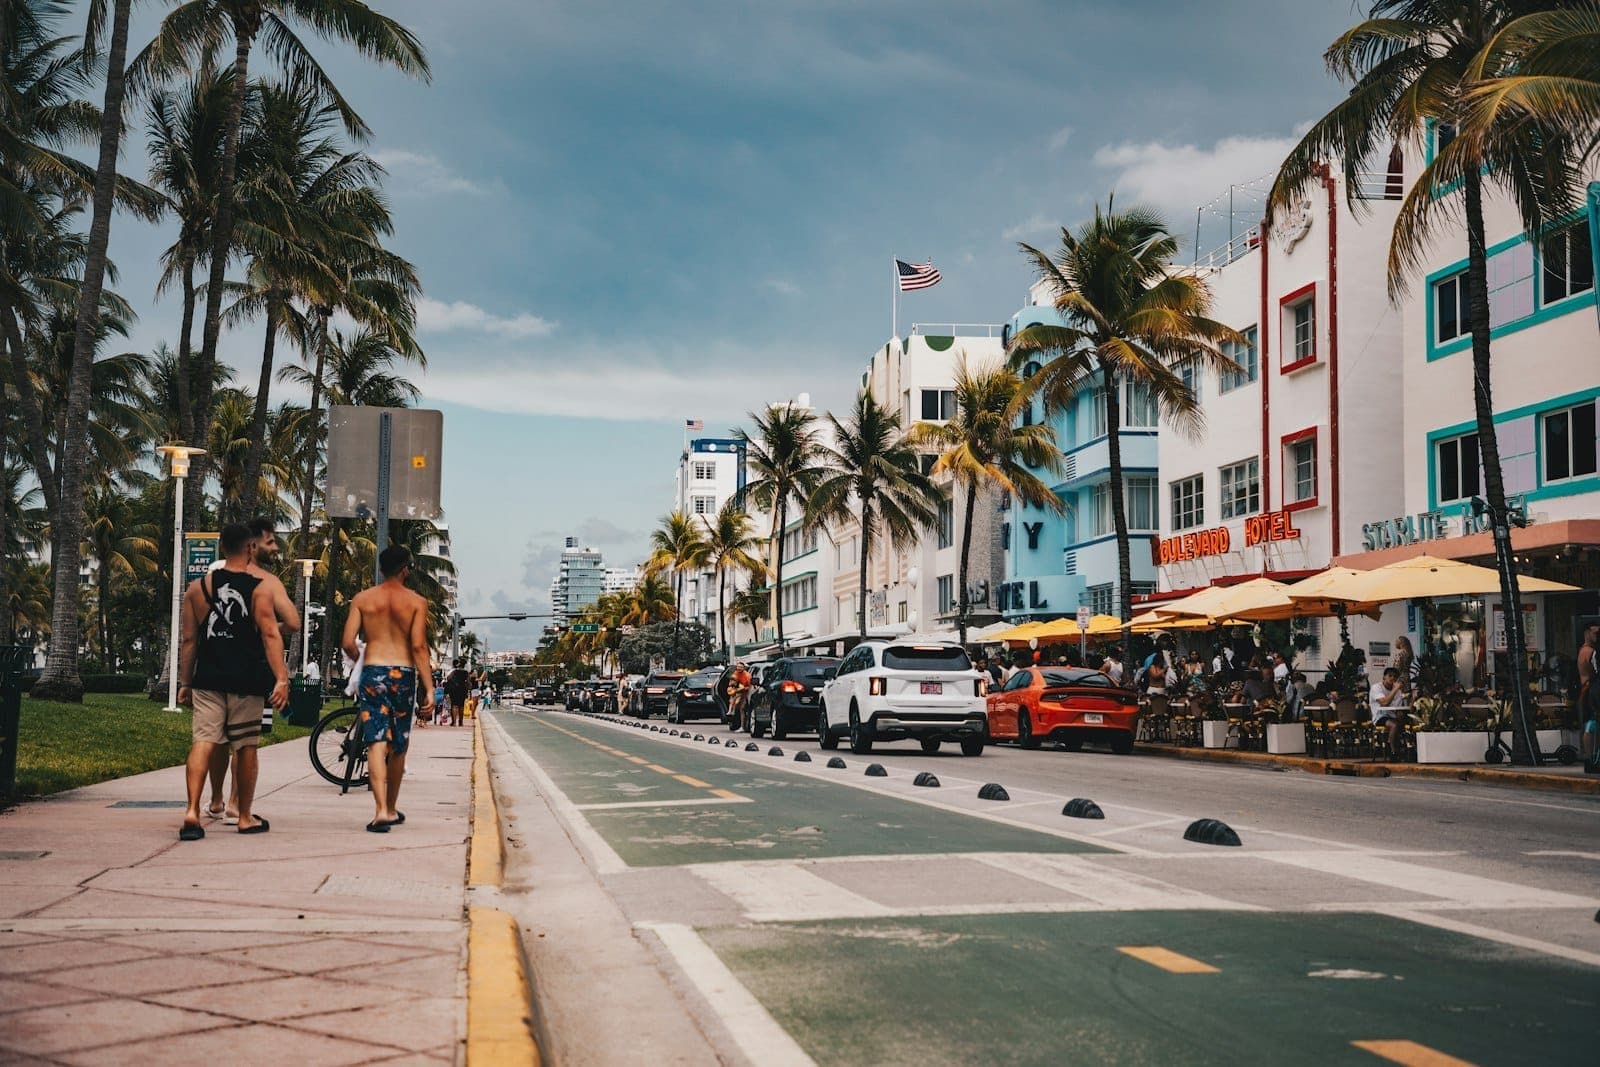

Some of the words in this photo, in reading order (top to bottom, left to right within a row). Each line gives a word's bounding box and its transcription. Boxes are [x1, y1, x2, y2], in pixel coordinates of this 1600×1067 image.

[1151, 526, 1230, 566] OULEVARD
[1245, 511, 1301, 548] HOTEL
[1362, 510, 1449, 551] STARLITE
[1462, 494, 1536, 536] HOEL
[188, 565, 209, 573] DEC
